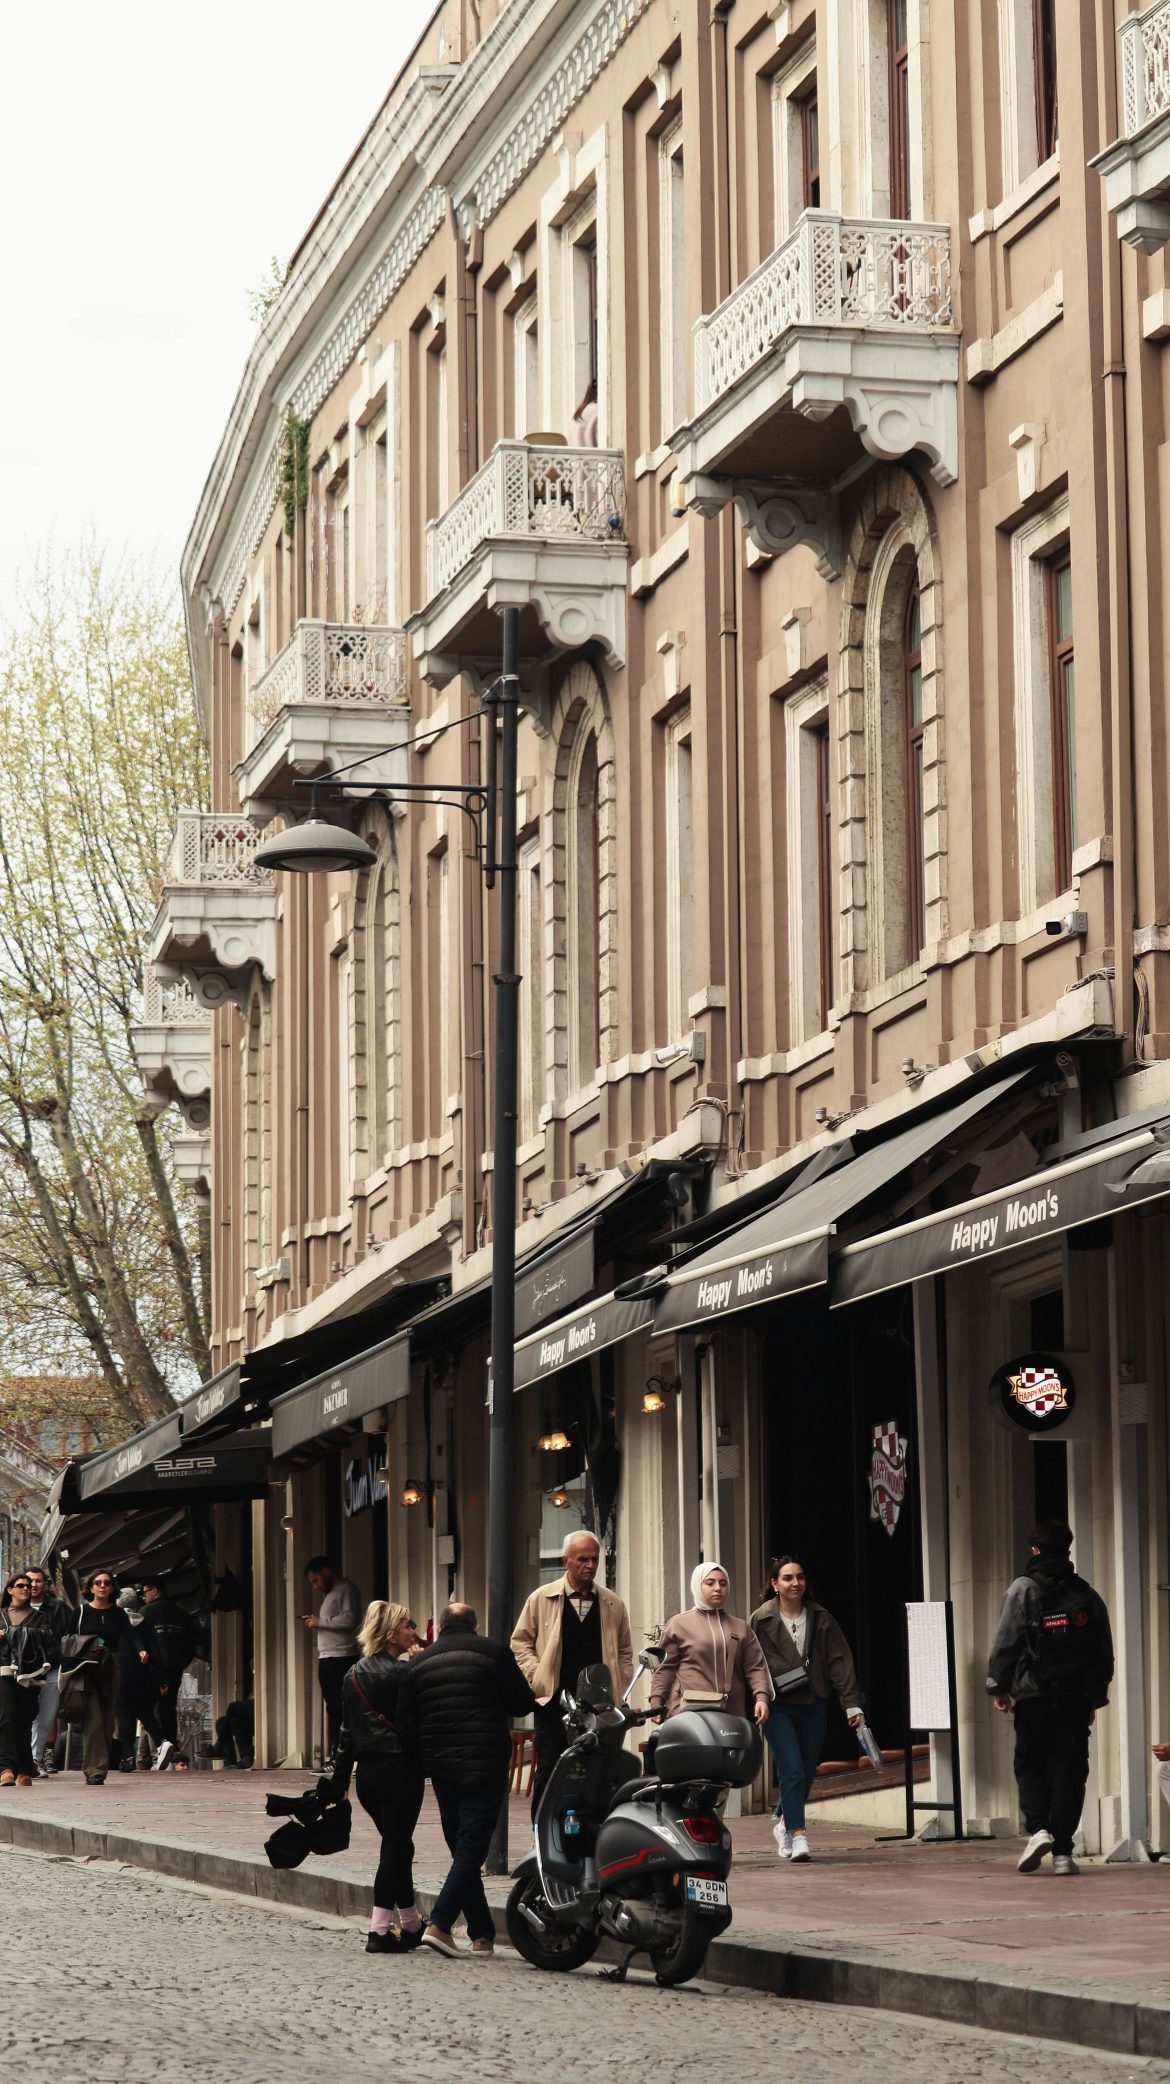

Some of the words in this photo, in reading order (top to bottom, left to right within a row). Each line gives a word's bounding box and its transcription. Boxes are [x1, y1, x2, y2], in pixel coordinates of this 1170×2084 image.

[951, 1215, 998, 1252] Happy
[1005, 1189, 1059, 1233] Moon's
[697, 1279, 732, 1310] Happy
[737, 1259, 773, 1296] Moon's
[539, 1338, 565, 1367] Happy
[567, 1317, 596, 1352] Moon's
[688, 1879, 701, 1889] 34
[705, 1881, 725, 1893] GDN
[699, 1891, 719, 1903] 256
